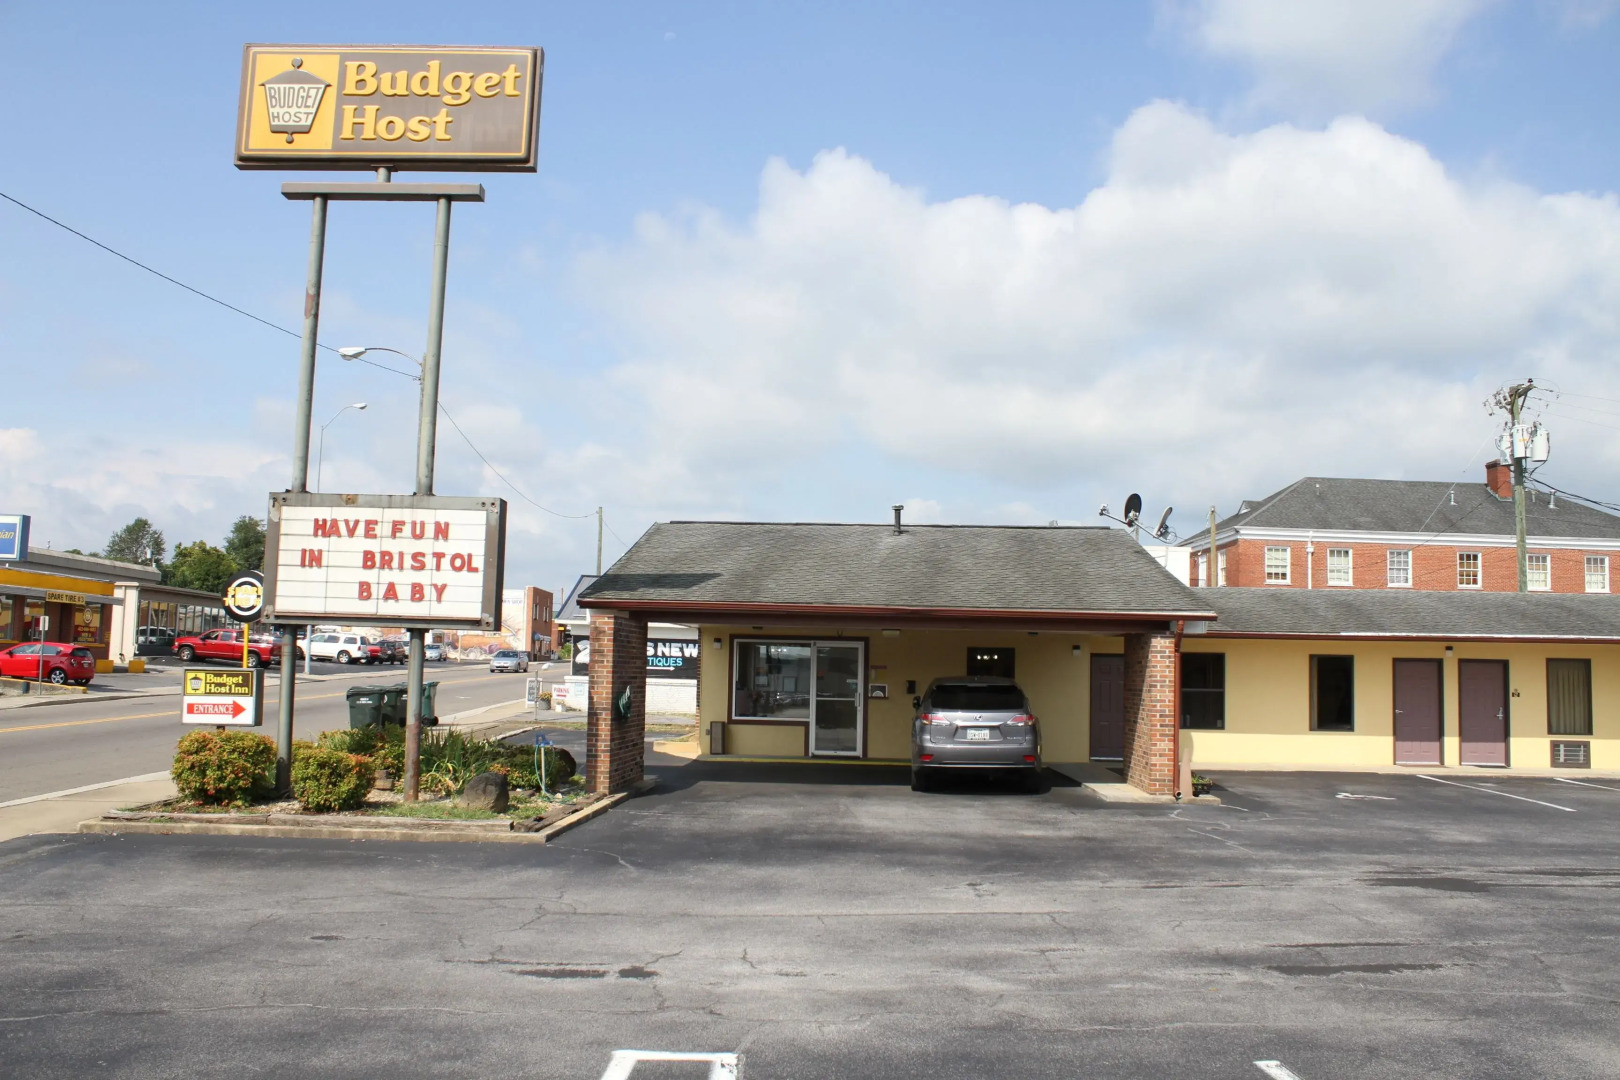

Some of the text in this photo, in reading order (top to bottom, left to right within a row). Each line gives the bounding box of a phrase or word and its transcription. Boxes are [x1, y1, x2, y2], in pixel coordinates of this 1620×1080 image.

[342, 60, 522, 106] Budget
[268, 85, 324, 109] BUDGET
[271, 111, 314, 124] HOST
[339, 105, 454, 142] Host
[0, 529, 15, 539] ian
[313, 518, 450, 540] HAVE FUN
[300, 548, 479, 573] IN BRISTOL
[47, 592, 64, 601] SPARE
[65, 594, 77, 602] TIRE
[357, 581, 447, 603] BABY
[657, 642, 698, 658] NEW
[648, 657, 683, 667] TIQUES
[206, 674, 243, 686] Budget
[206, 684, 230, 693] Host
[231, 685, 249, 694] Inn
[193, 704, 234, 714] ENTRANCE
